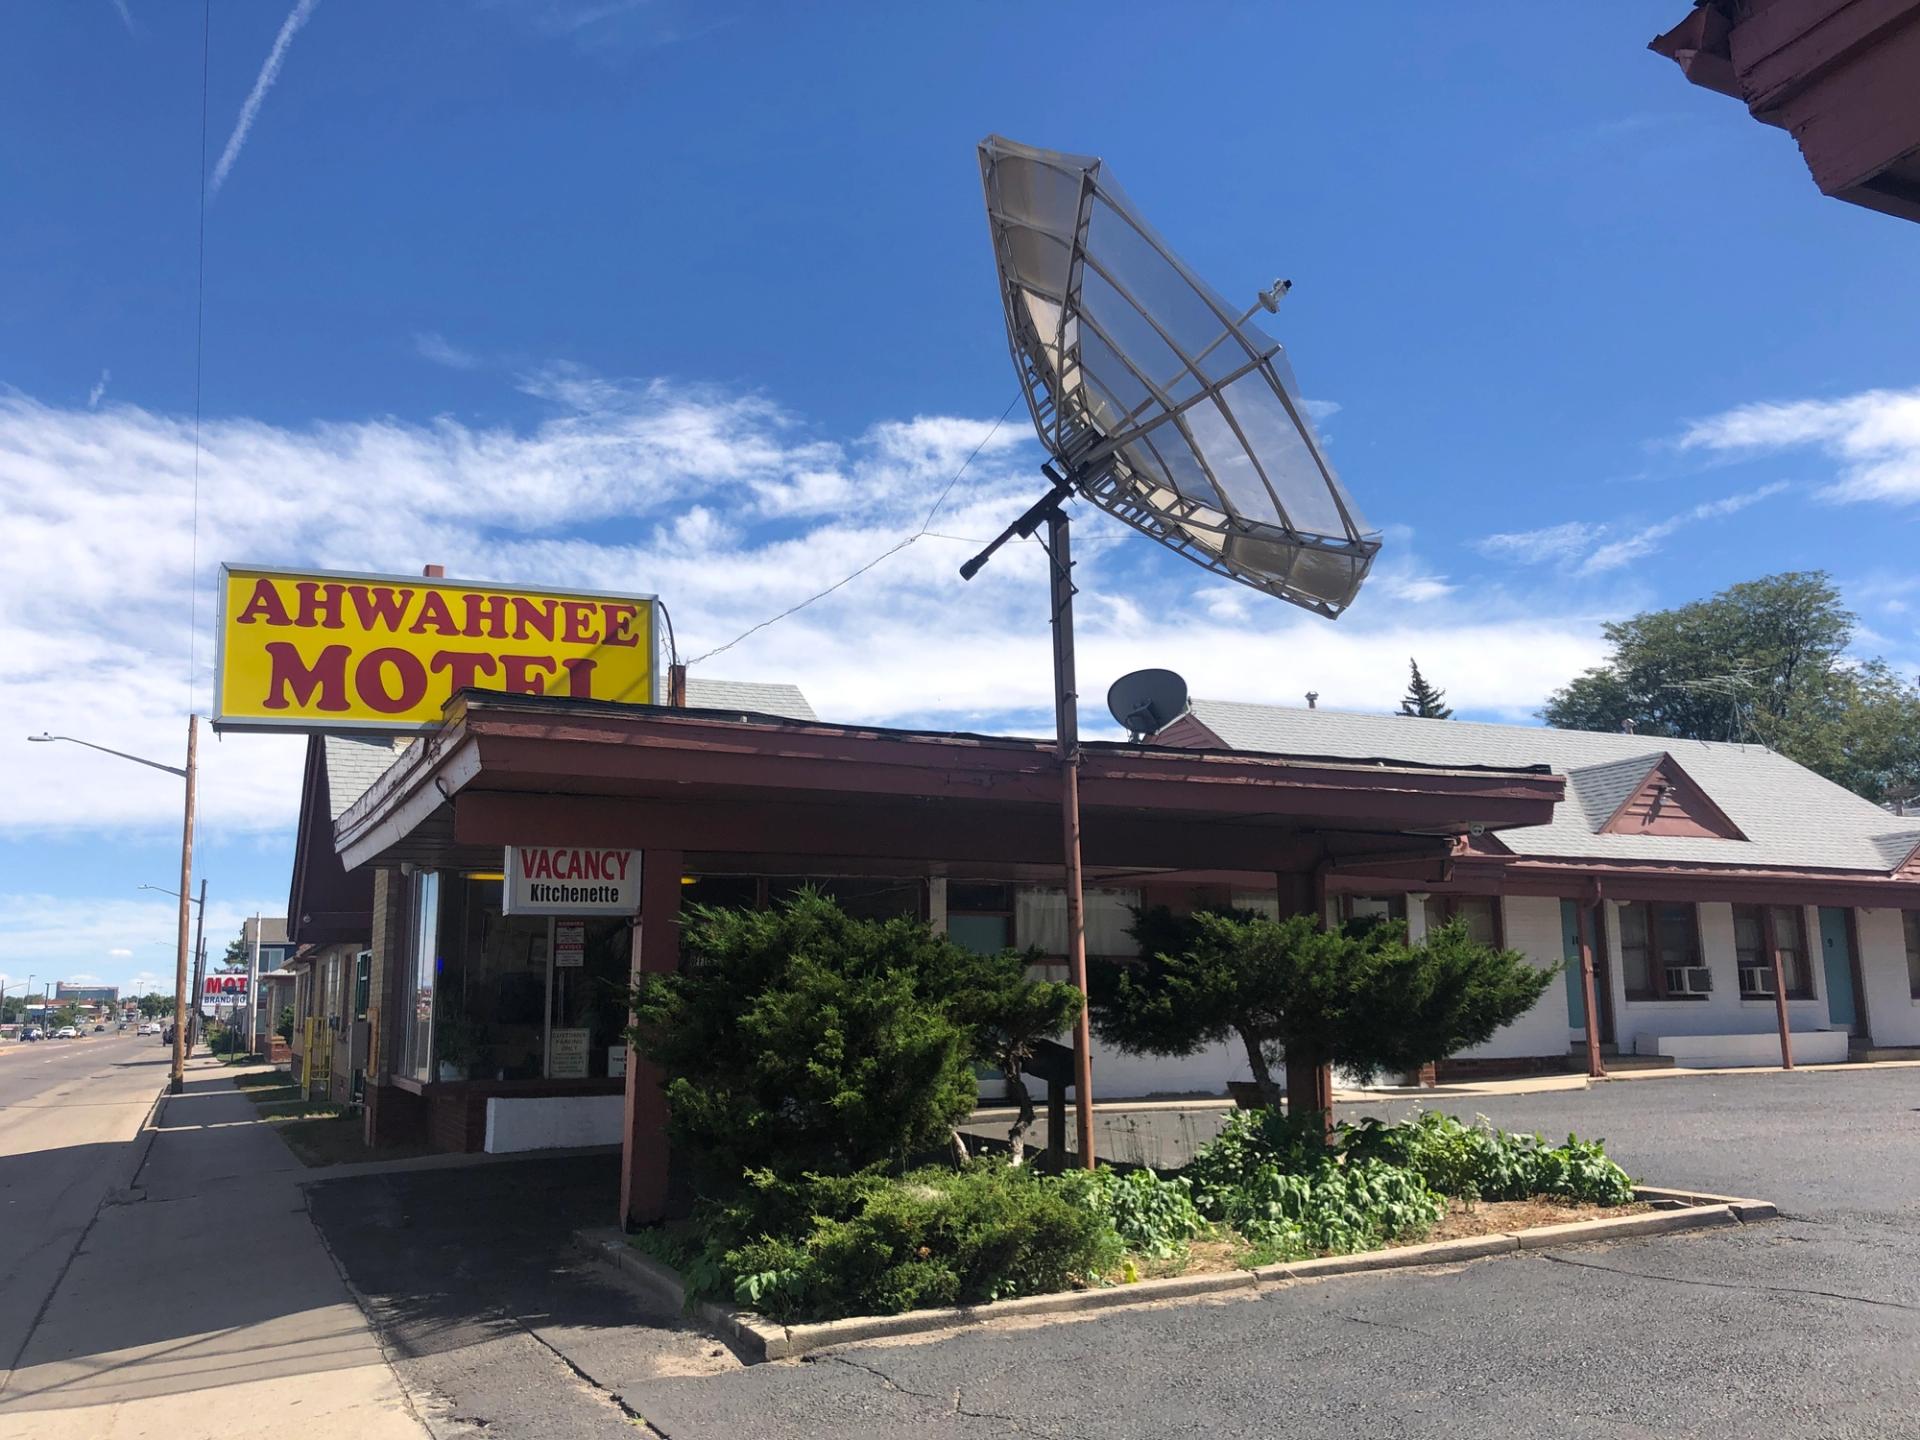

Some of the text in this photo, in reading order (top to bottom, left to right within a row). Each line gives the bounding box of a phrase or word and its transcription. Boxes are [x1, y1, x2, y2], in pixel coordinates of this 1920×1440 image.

[237, 578, 640, 647] AHWAHNEE
[521, 848, 631, 880] VACANCY
[530, 883, 619, 903] Kitchenette
